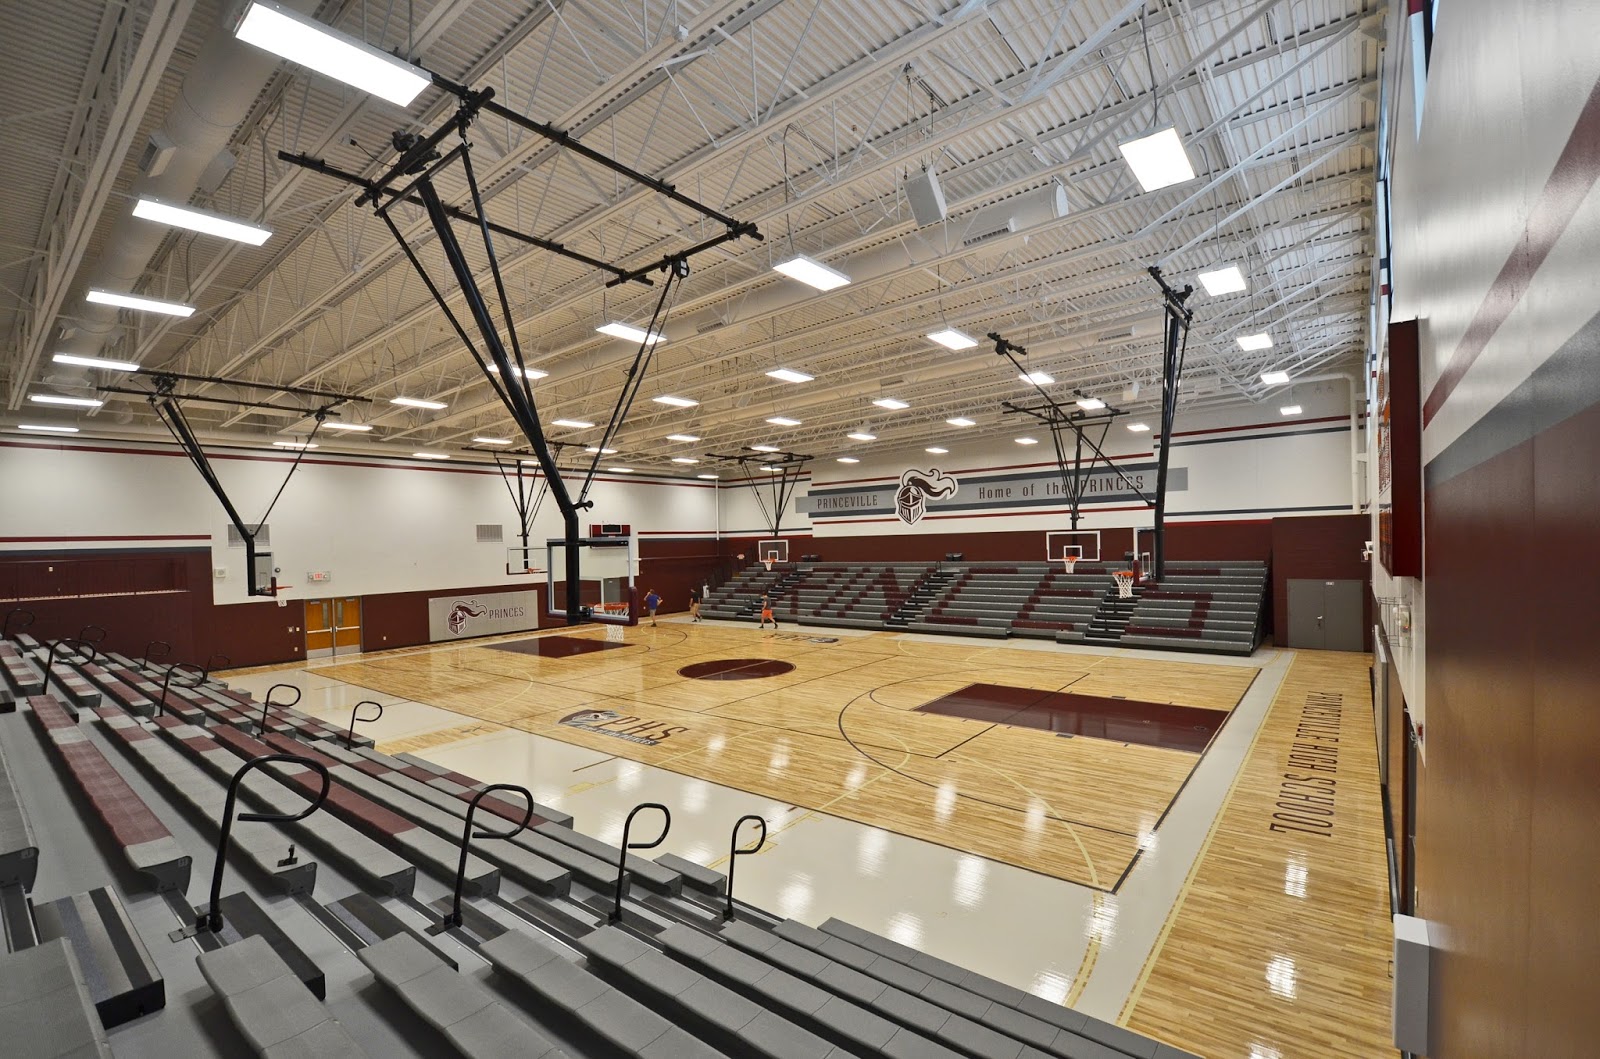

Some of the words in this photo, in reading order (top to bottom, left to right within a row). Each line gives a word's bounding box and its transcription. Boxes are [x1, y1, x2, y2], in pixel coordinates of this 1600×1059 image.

[978, 487, 1012, 499] Home
[1022, 483, 1035, 497] of
[1046, 481, 1066, 495] the
[1080, 475, 1144, 494] PRINCES
[817, 494, 878, 509] PRINCEVILLE
[489, 606, 524, 619] PRINCES
[593, 716, 689, 740] PHS
[1295, 690, 1343, 742] PRINCEVILLE
[1287, 742, 1338, 773] HIGH
[1269, 773, 1337, 837] SCHOOL
